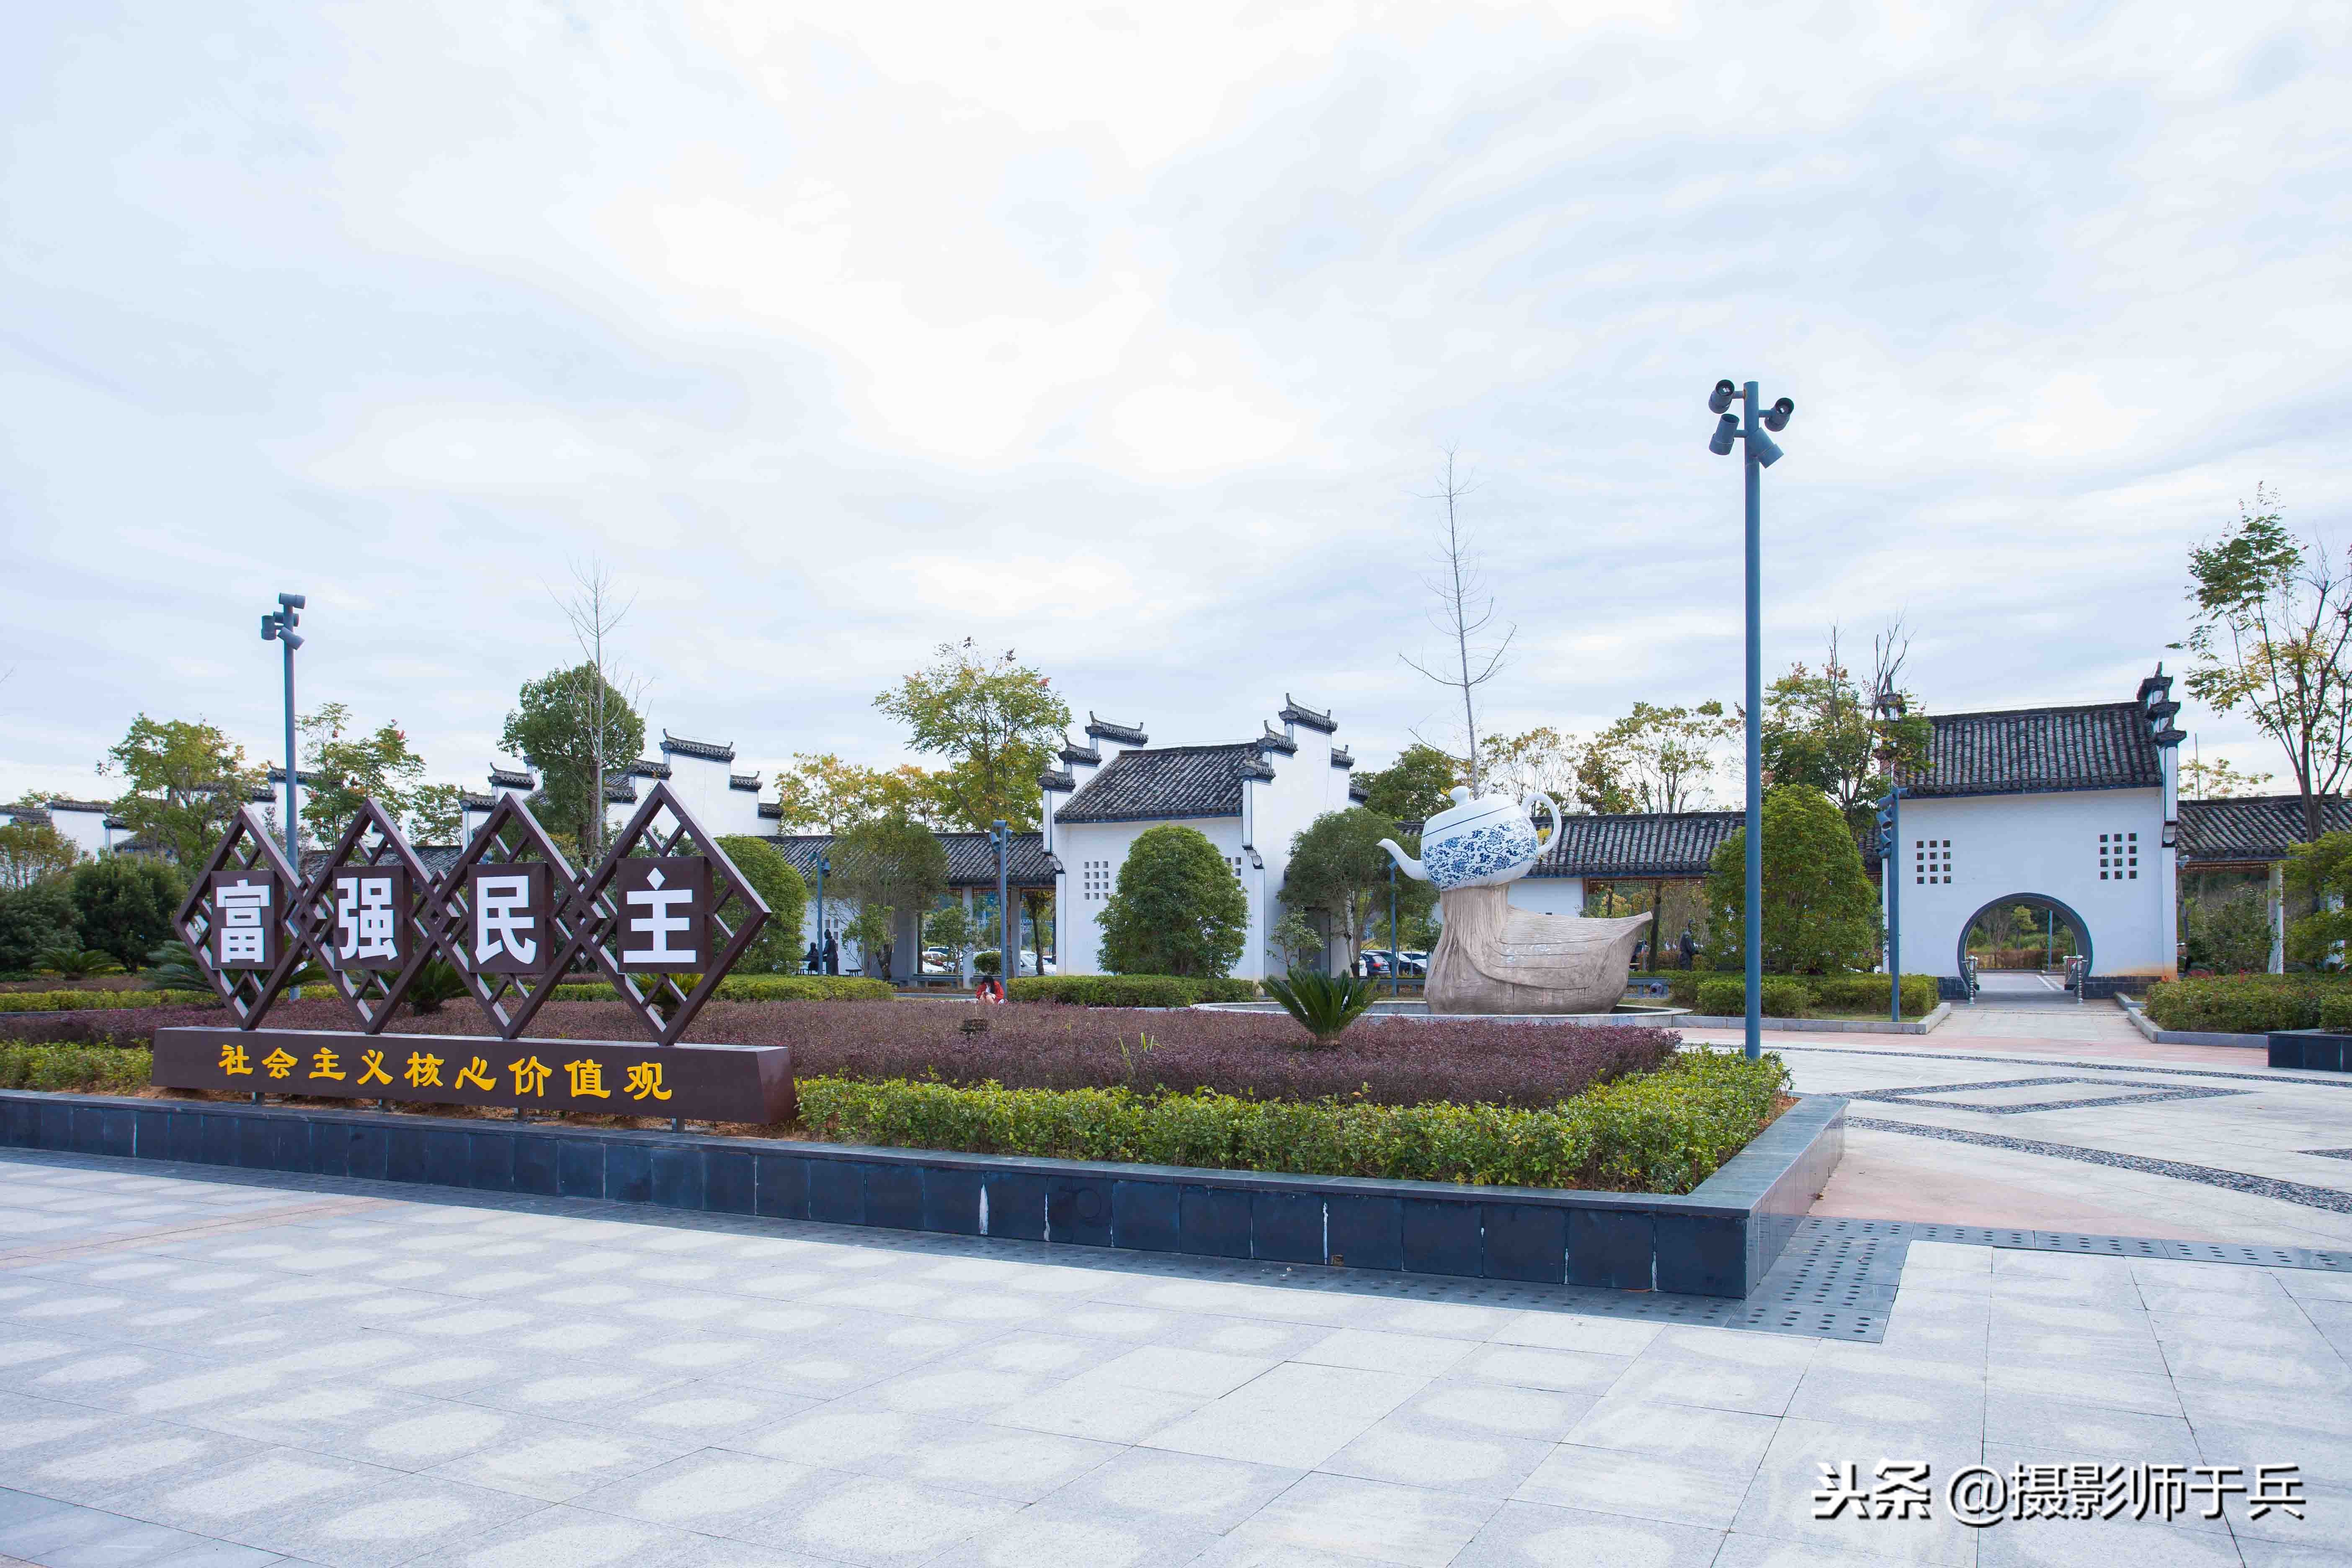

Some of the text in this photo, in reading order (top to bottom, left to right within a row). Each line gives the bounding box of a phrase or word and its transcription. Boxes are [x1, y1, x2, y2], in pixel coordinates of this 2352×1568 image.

[215, 867, 697, 965] 富强民主
[218, 1044, 673, 1101] 社会主义核心价值观
